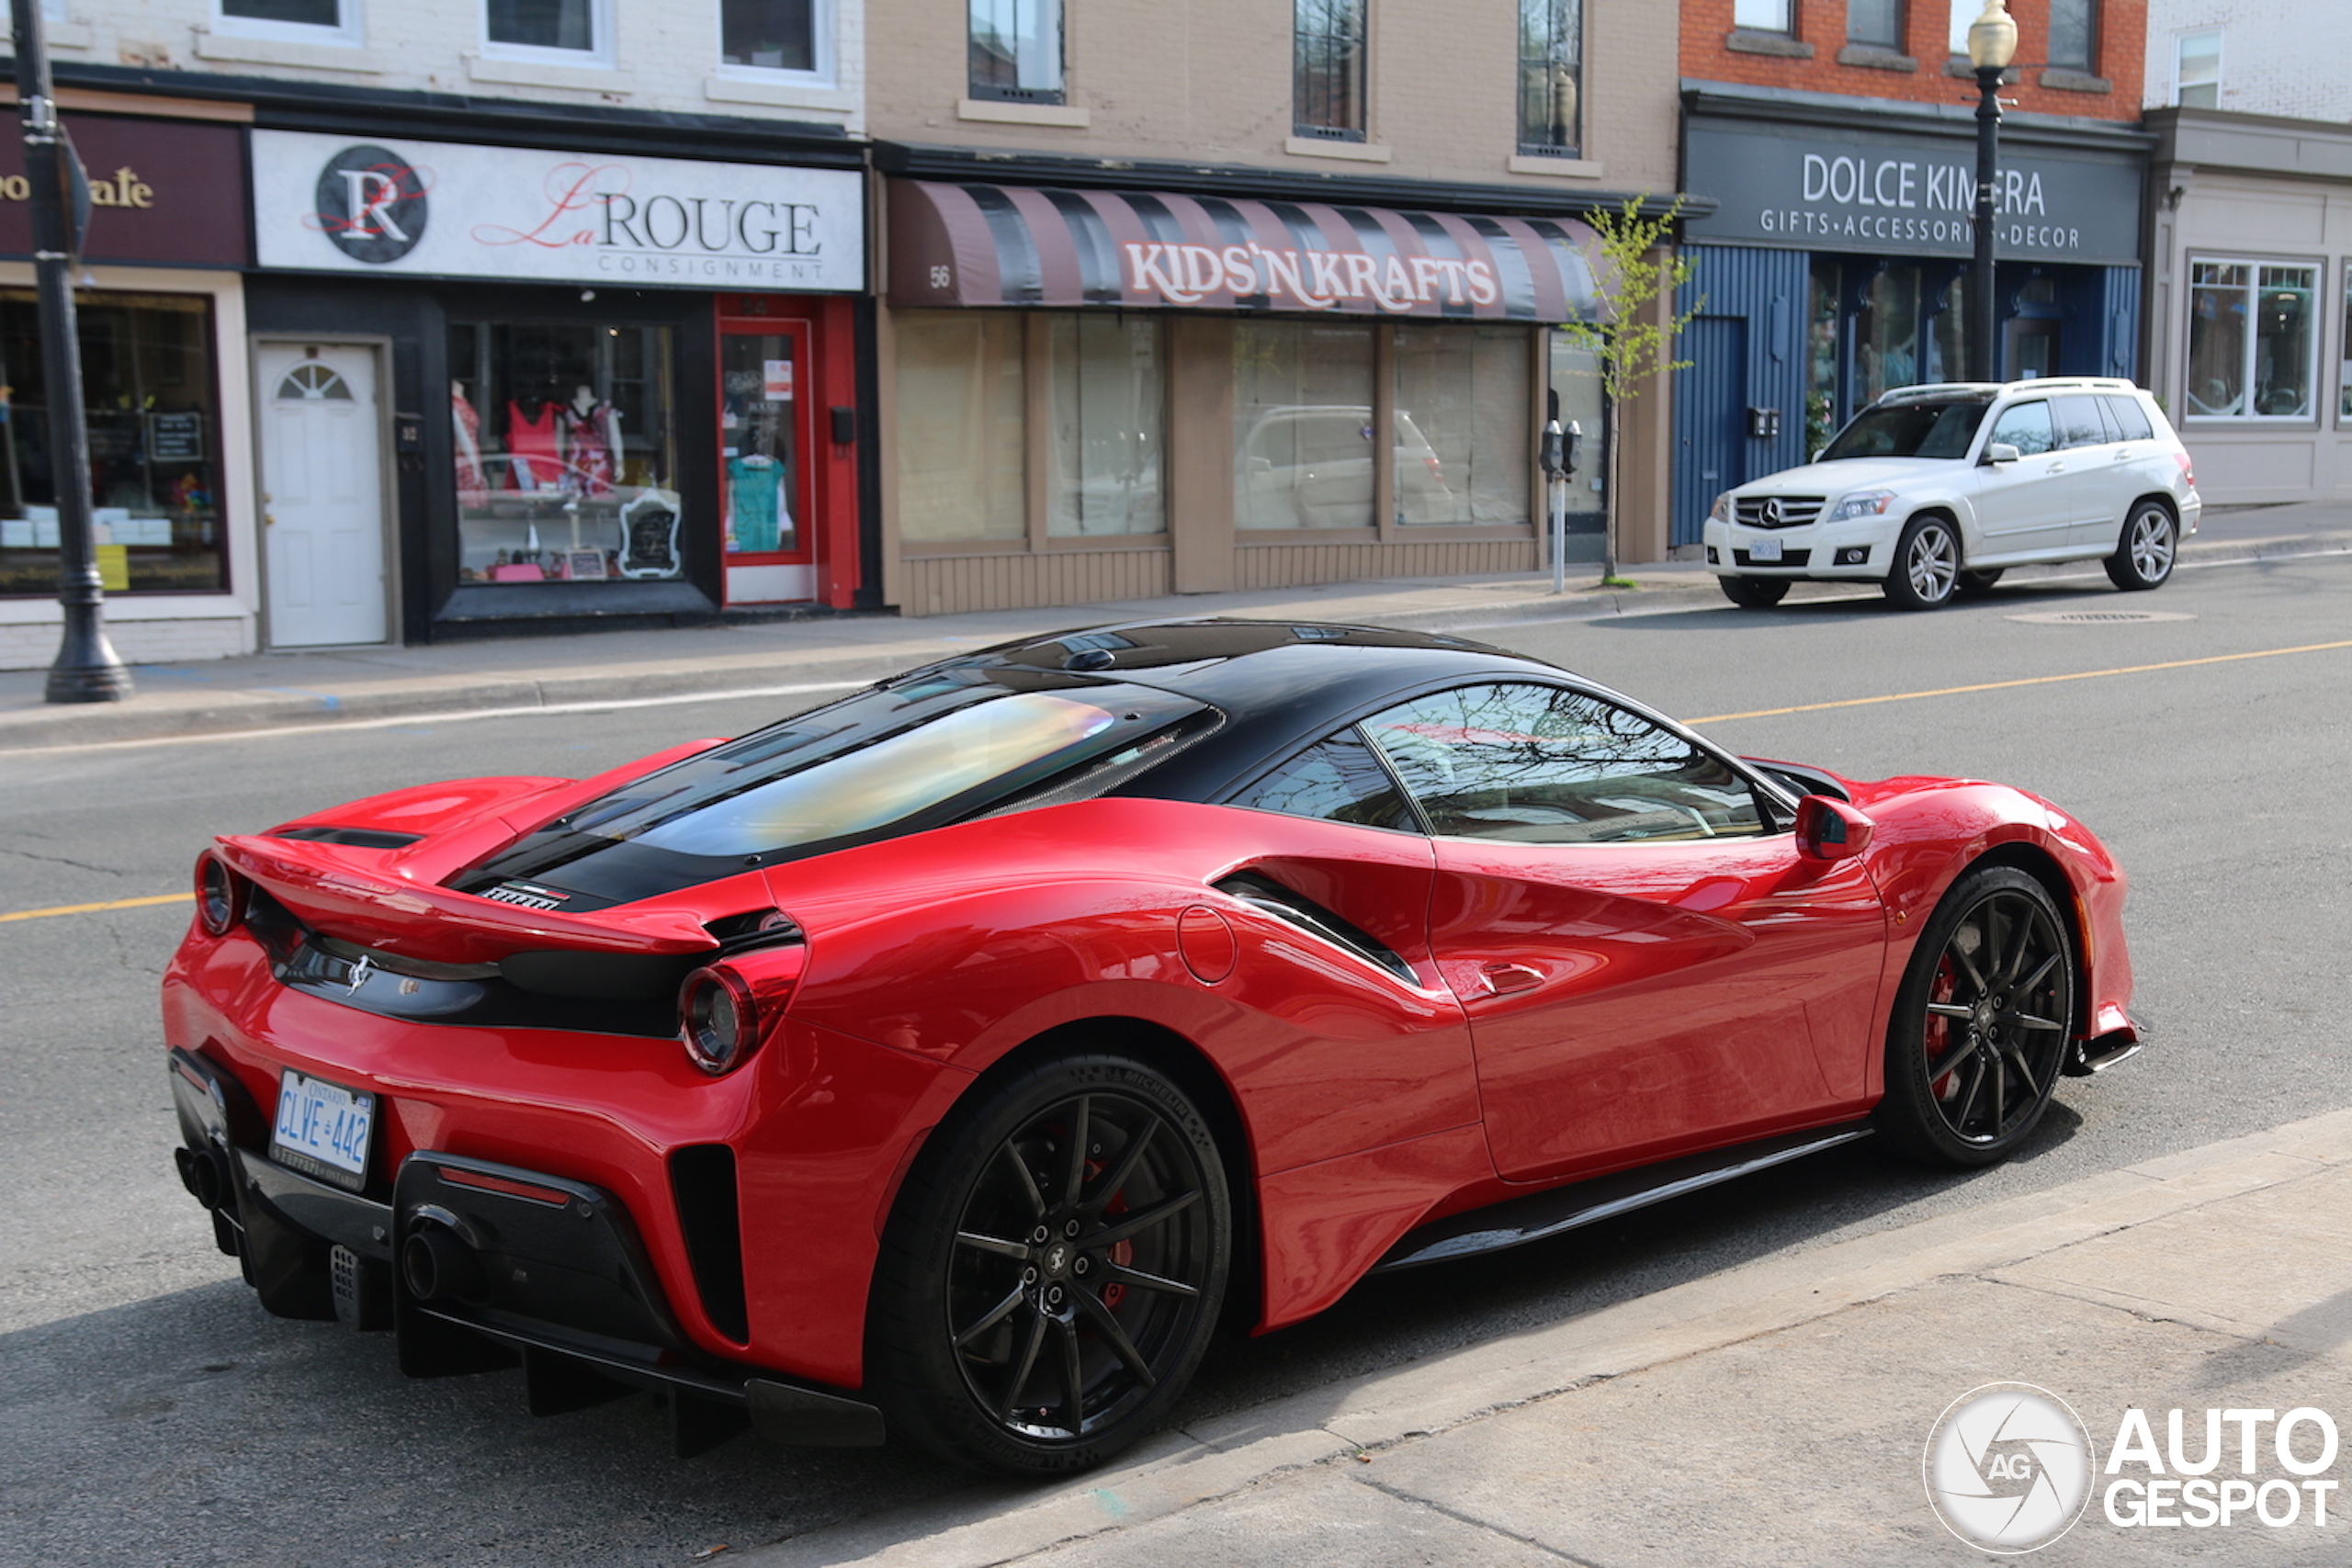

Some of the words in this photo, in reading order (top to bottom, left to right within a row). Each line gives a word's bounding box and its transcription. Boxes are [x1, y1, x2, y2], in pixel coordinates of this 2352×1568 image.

[1803, 153, 1917, 209] DOLCE
[469, 162, 633, 248] La
[594, 191, 822, 255] ROUGE
[1760, 209, 1829, 235] GIFTS
[1843, 214, 1973, 243] ACCESSORI
[2010, 224, 2080, 249] DECOR
[597, 255, 823, 278] CONSIGNMENT
[930, 265, 951, 288] 56
[1306, 250, 1497, 311] KRAFTS
[1122, 1067, 1190, 1119] MICHELIN
[332, 1109, 368, 1164] 442
